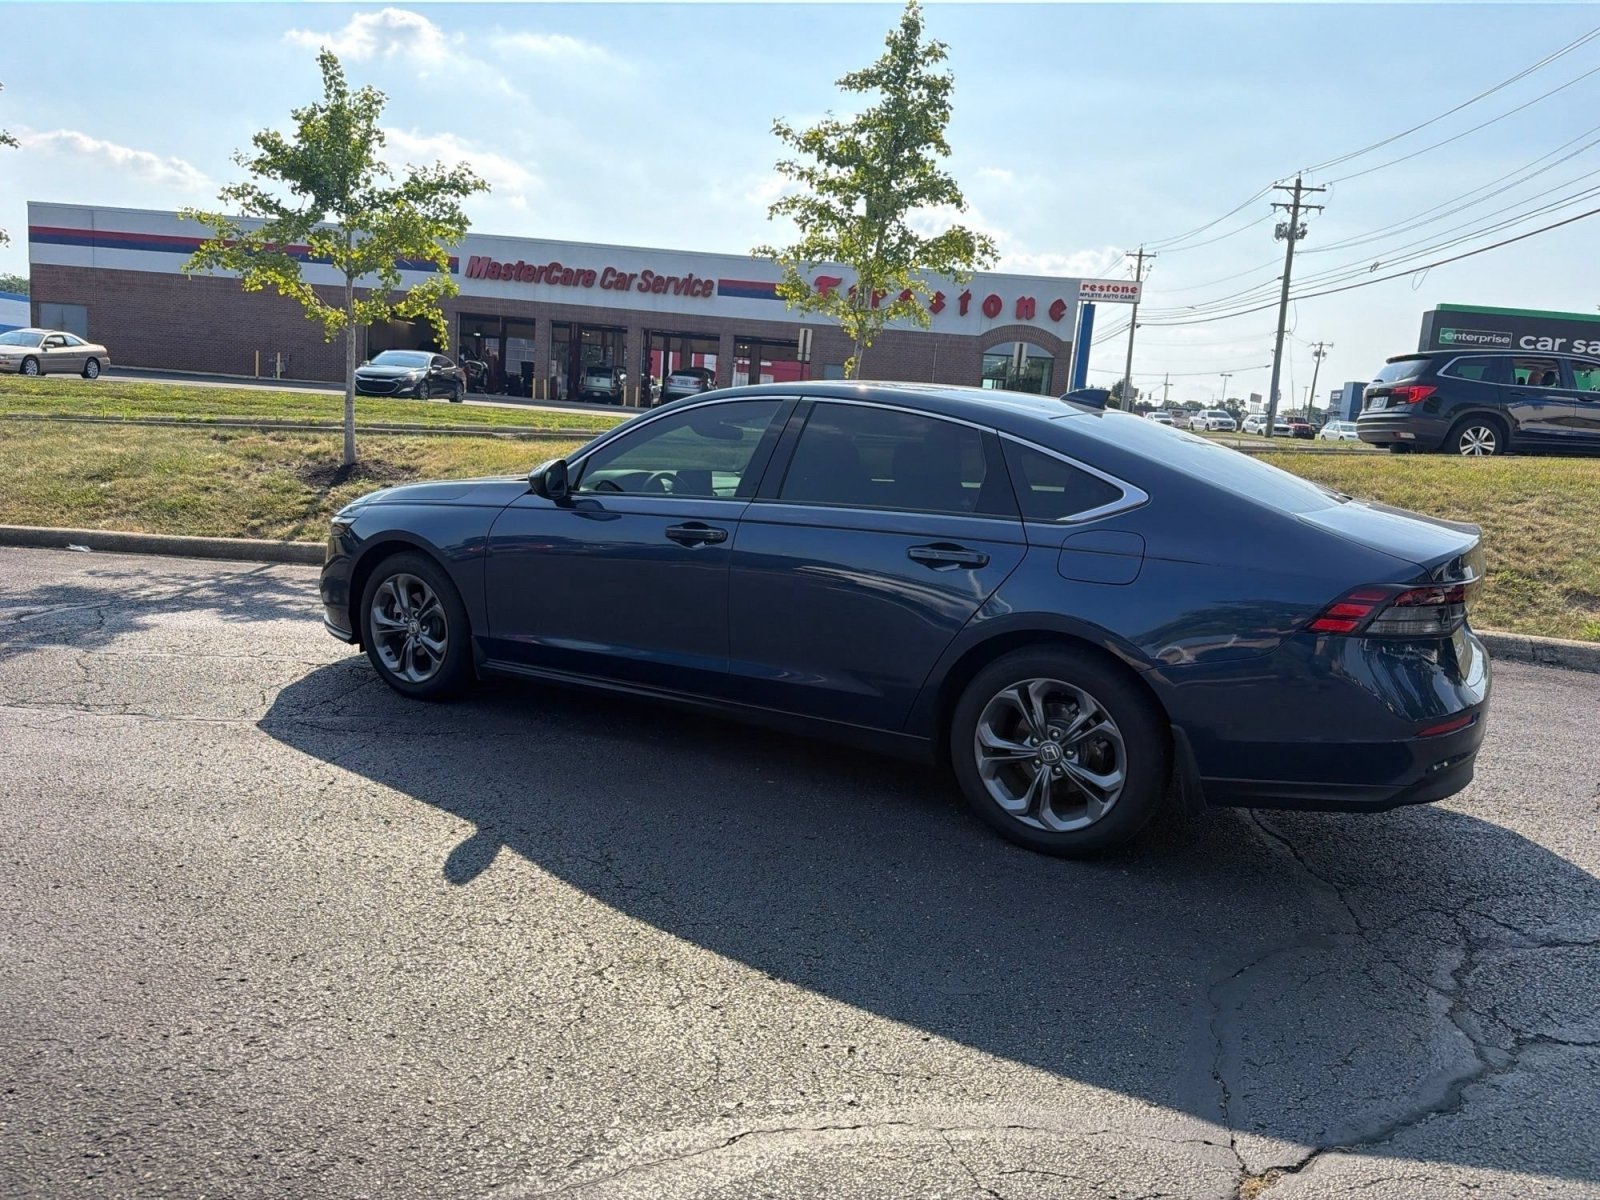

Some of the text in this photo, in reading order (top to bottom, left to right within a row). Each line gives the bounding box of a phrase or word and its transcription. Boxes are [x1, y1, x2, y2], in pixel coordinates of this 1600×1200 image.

[465, 255, 715, 298] MasterCare Car Service
[1444, 332, 1511, 344] enterprise
[1519, 335, 1567, 352] car
